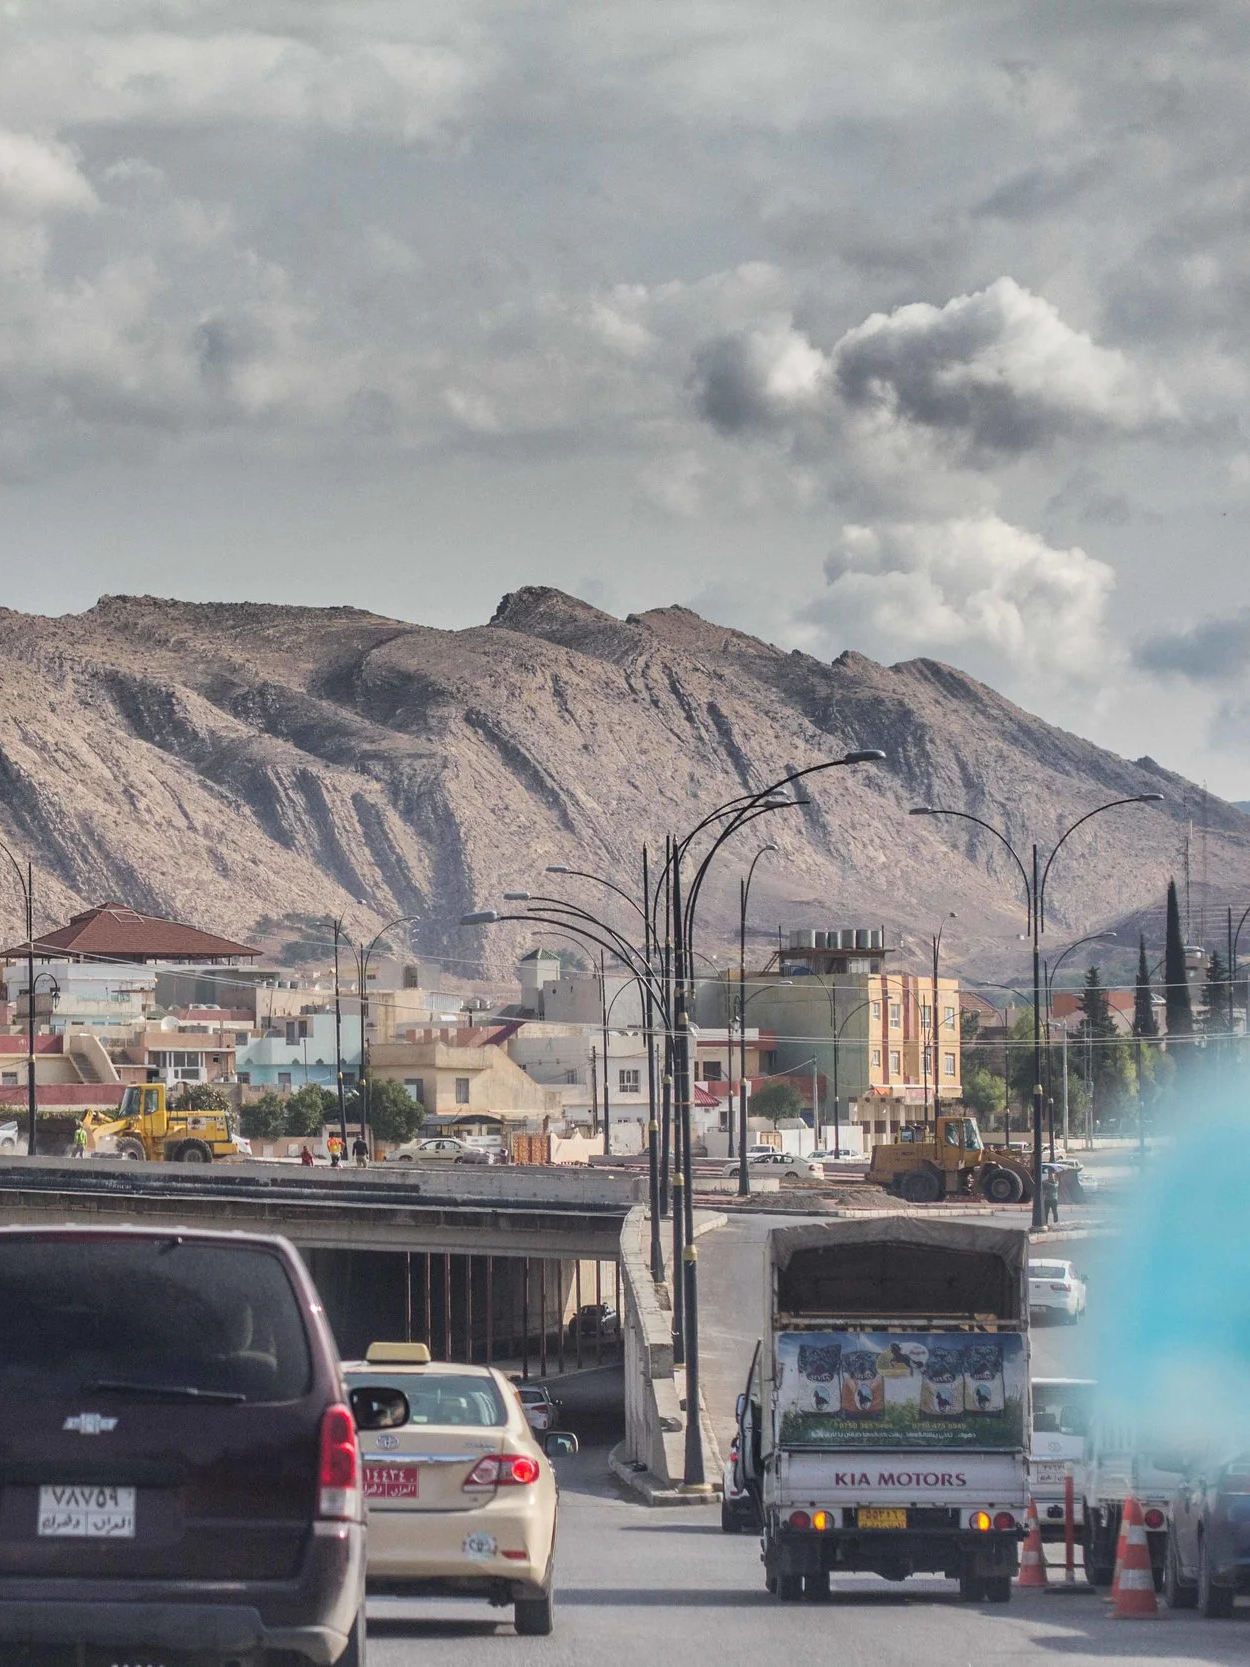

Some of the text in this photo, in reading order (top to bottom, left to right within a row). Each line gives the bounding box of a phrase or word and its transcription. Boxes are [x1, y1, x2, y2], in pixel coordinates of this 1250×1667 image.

[834, 1472, 967, 1487] KIA MOTORS
[52, 1487, 119, 1508] ٧٨٧٥٩
